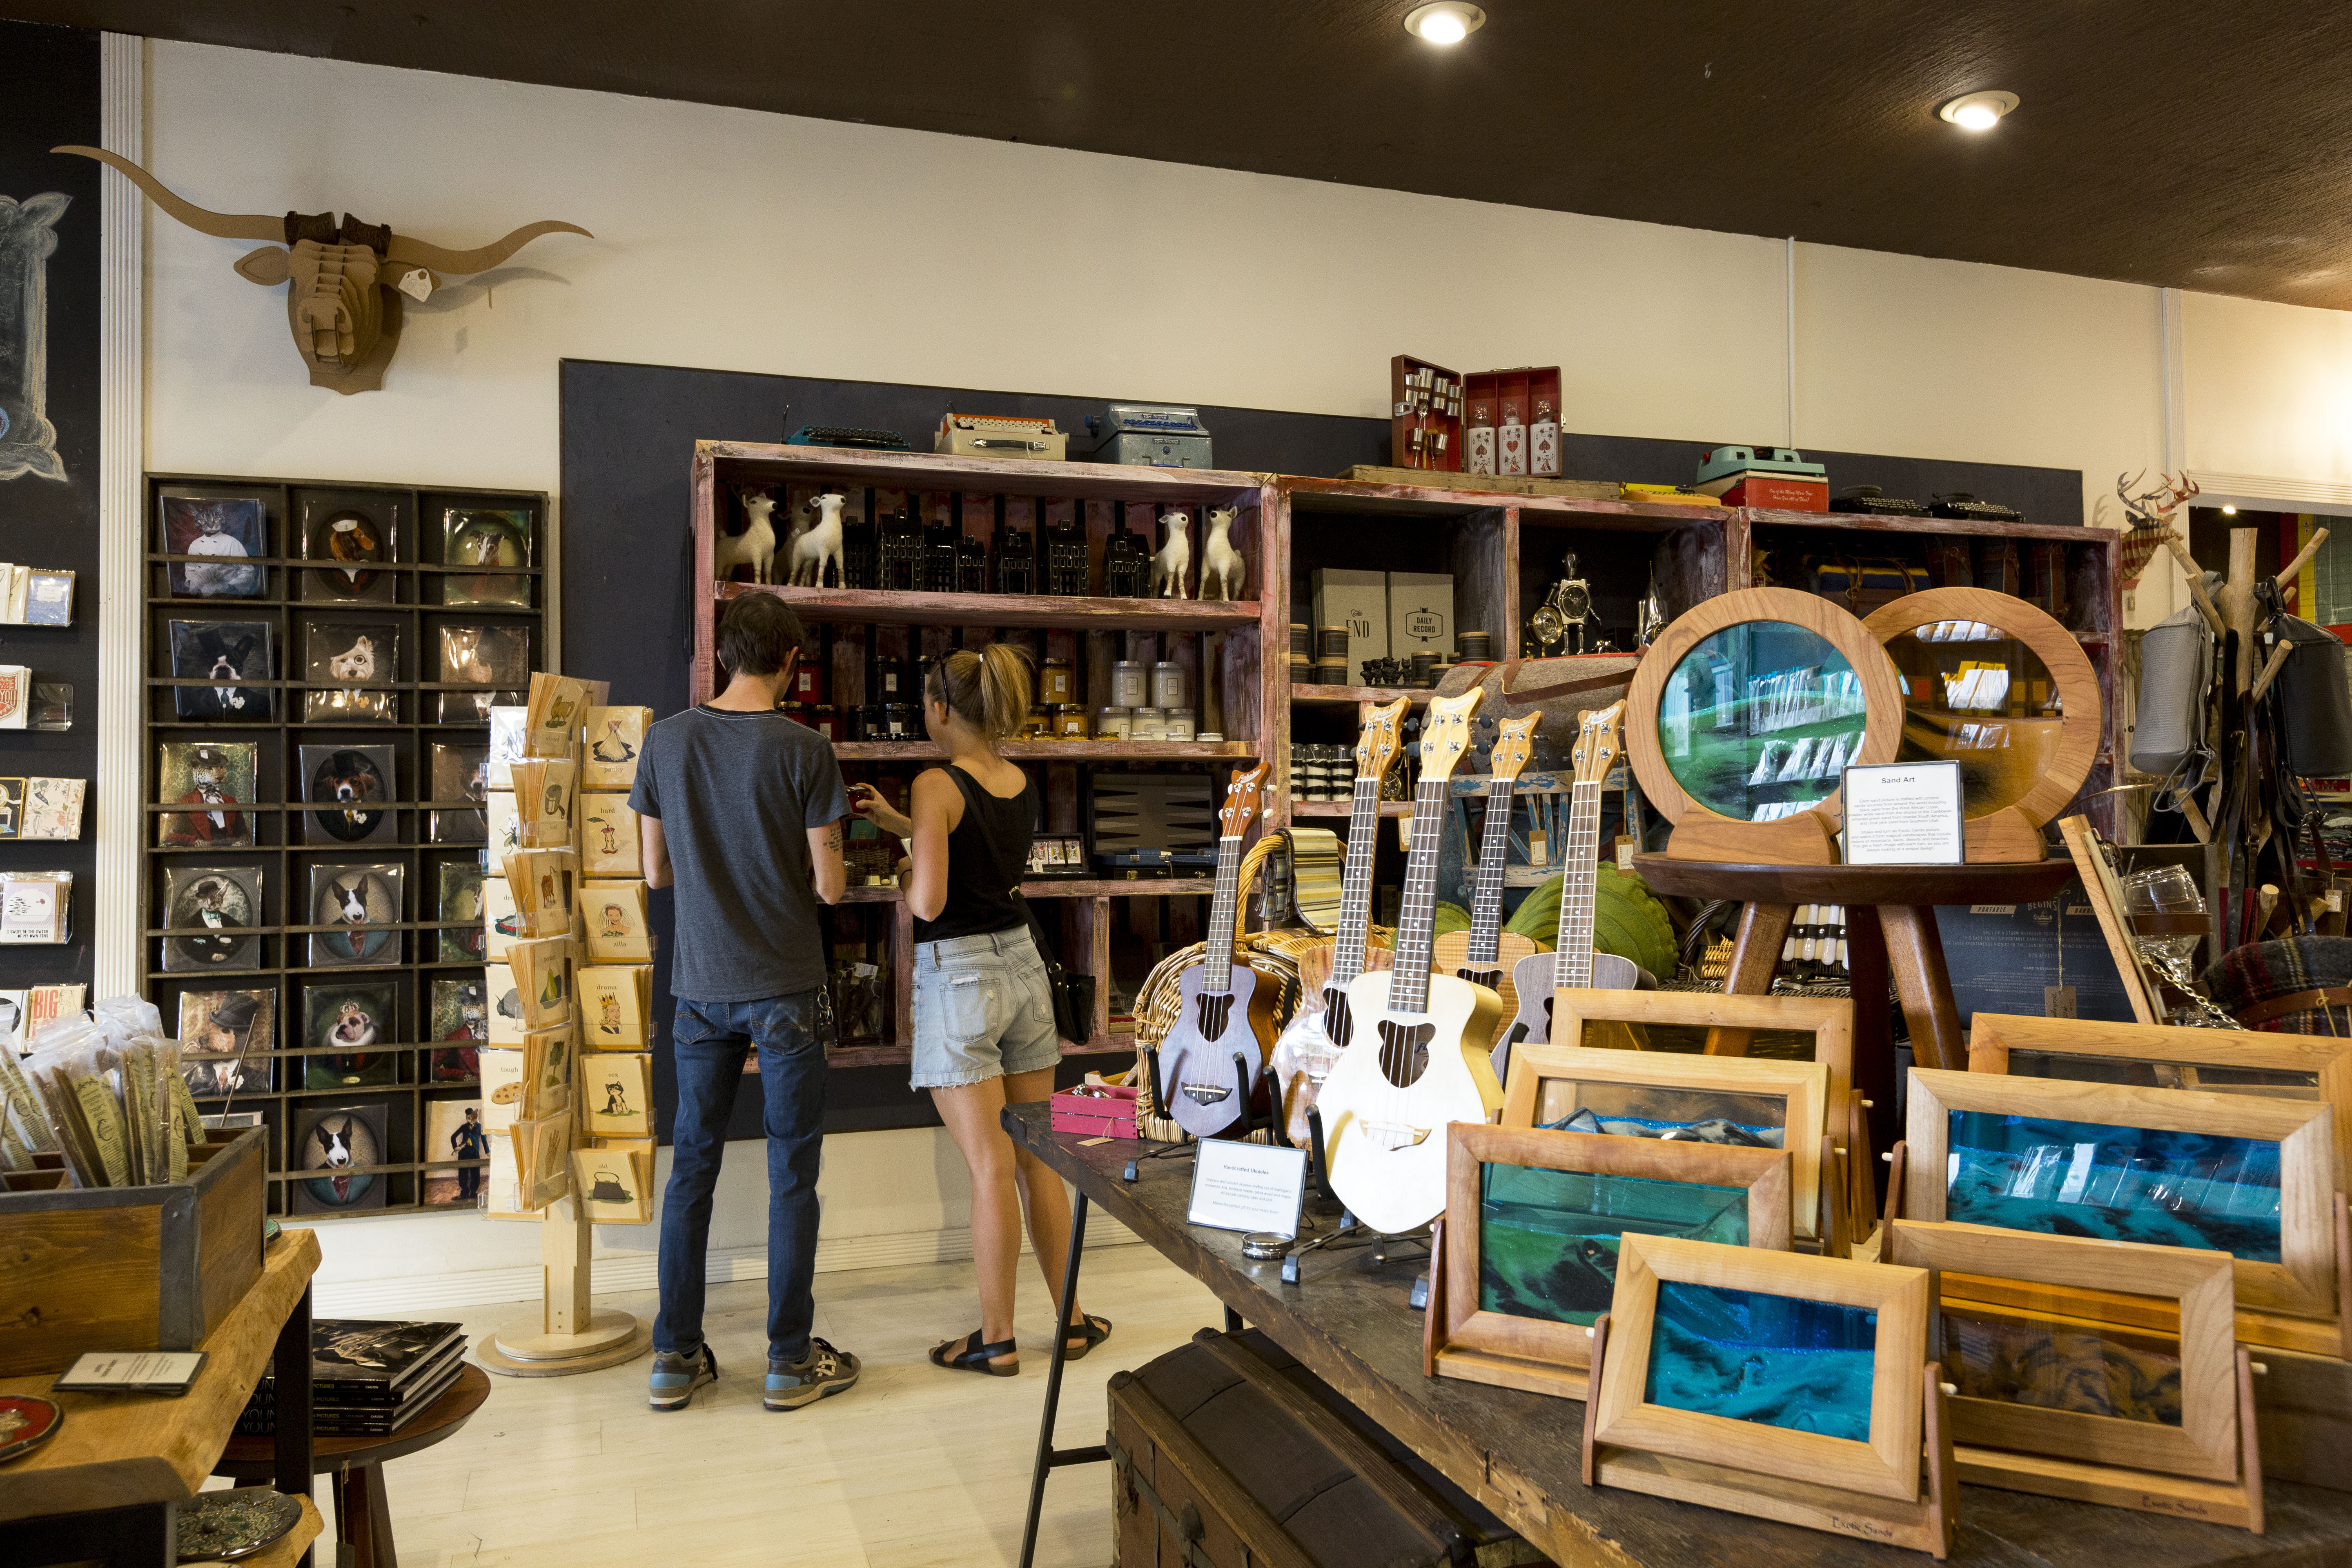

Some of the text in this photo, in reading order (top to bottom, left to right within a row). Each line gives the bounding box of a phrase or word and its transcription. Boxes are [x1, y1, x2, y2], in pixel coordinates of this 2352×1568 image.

[0, 690, 16, 706] YOU
[33, 989, 58, 1019] BIG
[1864, 1522, 1893, 1537] Sands
